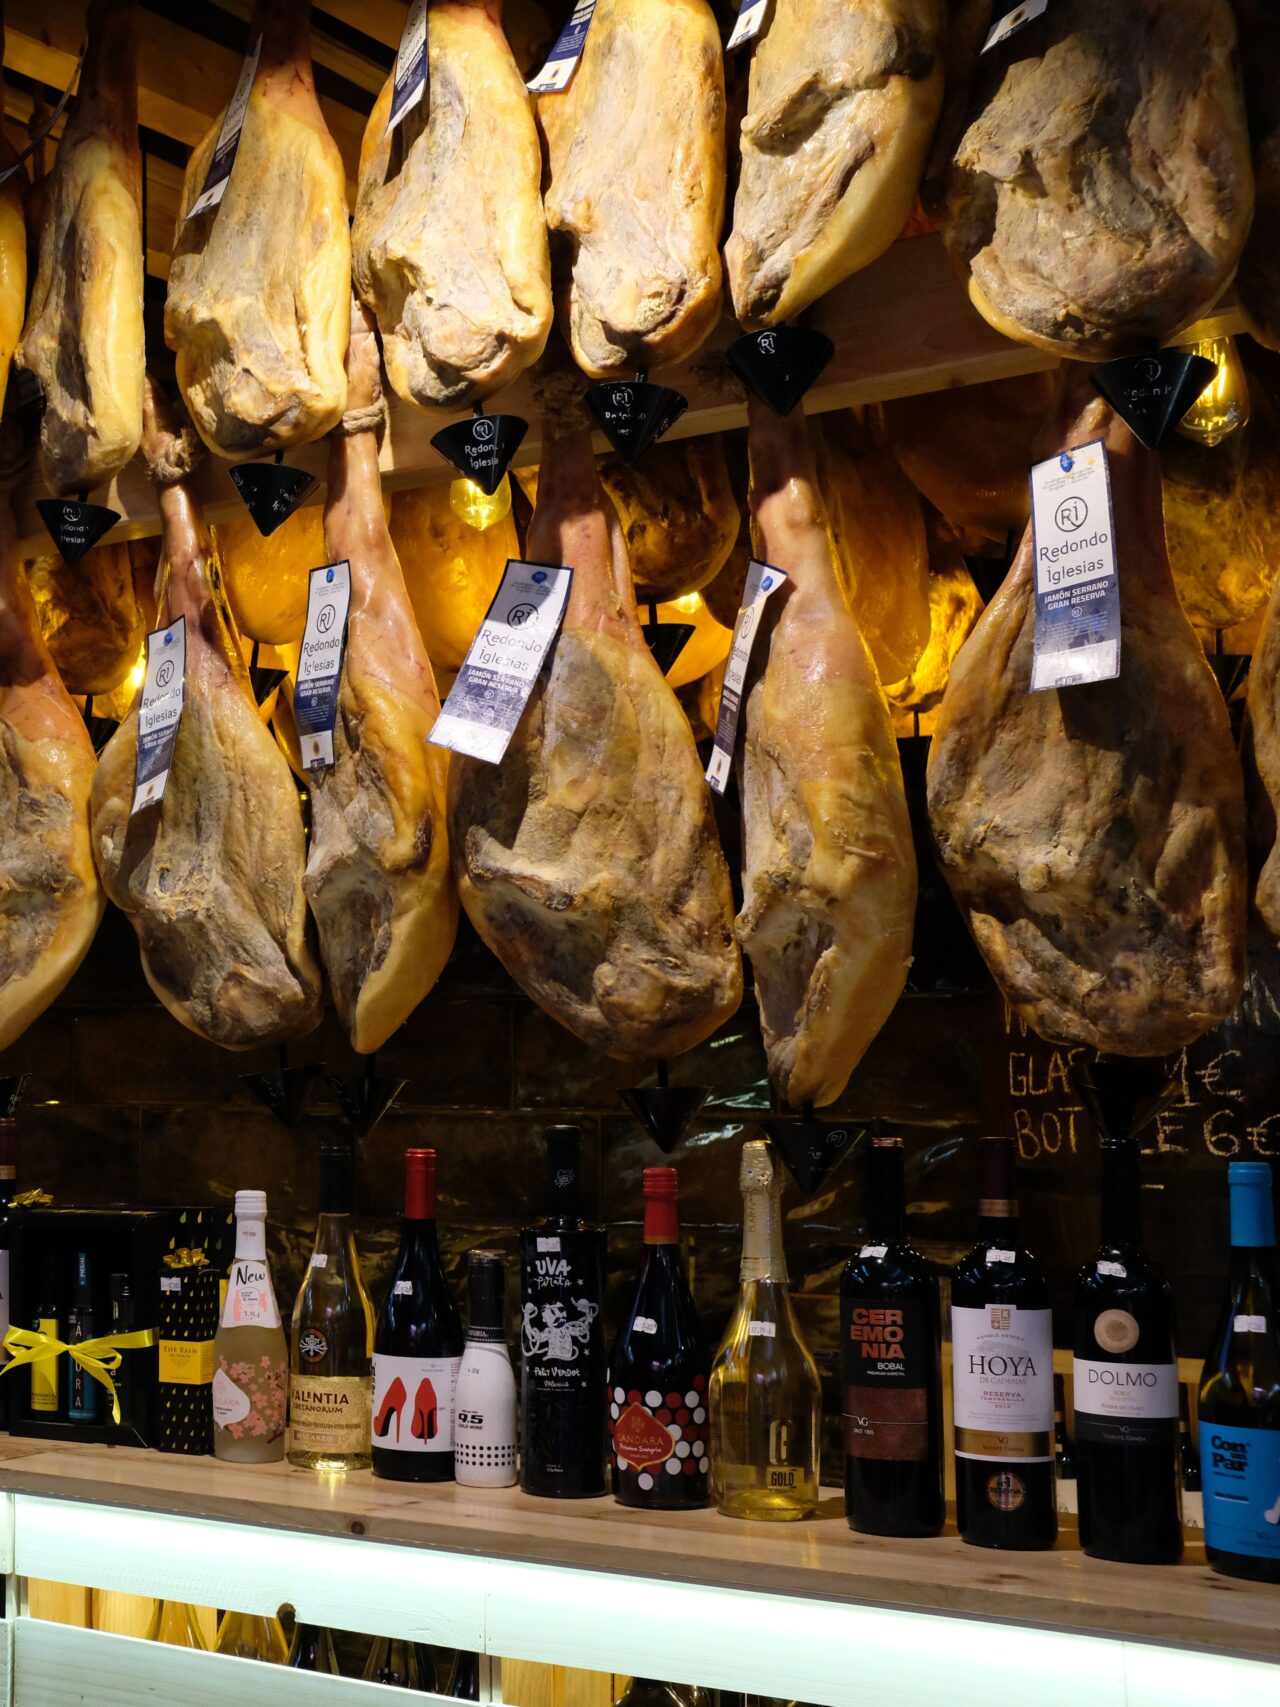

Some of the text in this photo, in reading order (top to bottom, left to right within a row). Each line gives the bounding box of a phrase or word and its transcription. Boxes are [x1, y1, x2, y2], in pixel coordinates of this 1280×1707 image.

[1039, 532, 1108, 563] Redondo
[1072, 580, 1109, 597] SERRANO
[1048, 590, 1106, 610] GRAN RESERVA
[303, 636, 340, 657] Redondo
[481, 629, 542, 653] Redondo
[535, 1256, 572, 1276] UVA
[236, 1265, 266, 1287] New
[853, 1309, 904, 1325] CER
[850, 1325, 904, 1342] EMO
[861, 1343, 905, 1359] NIA
[877, 1362, 905, 1370] BOBAL
[969, 1354, 1037, 1377] HOYA
[1088, 1369, 1157, 1387] DOLMO
[771, 1472, 794, 1487] GOLD
